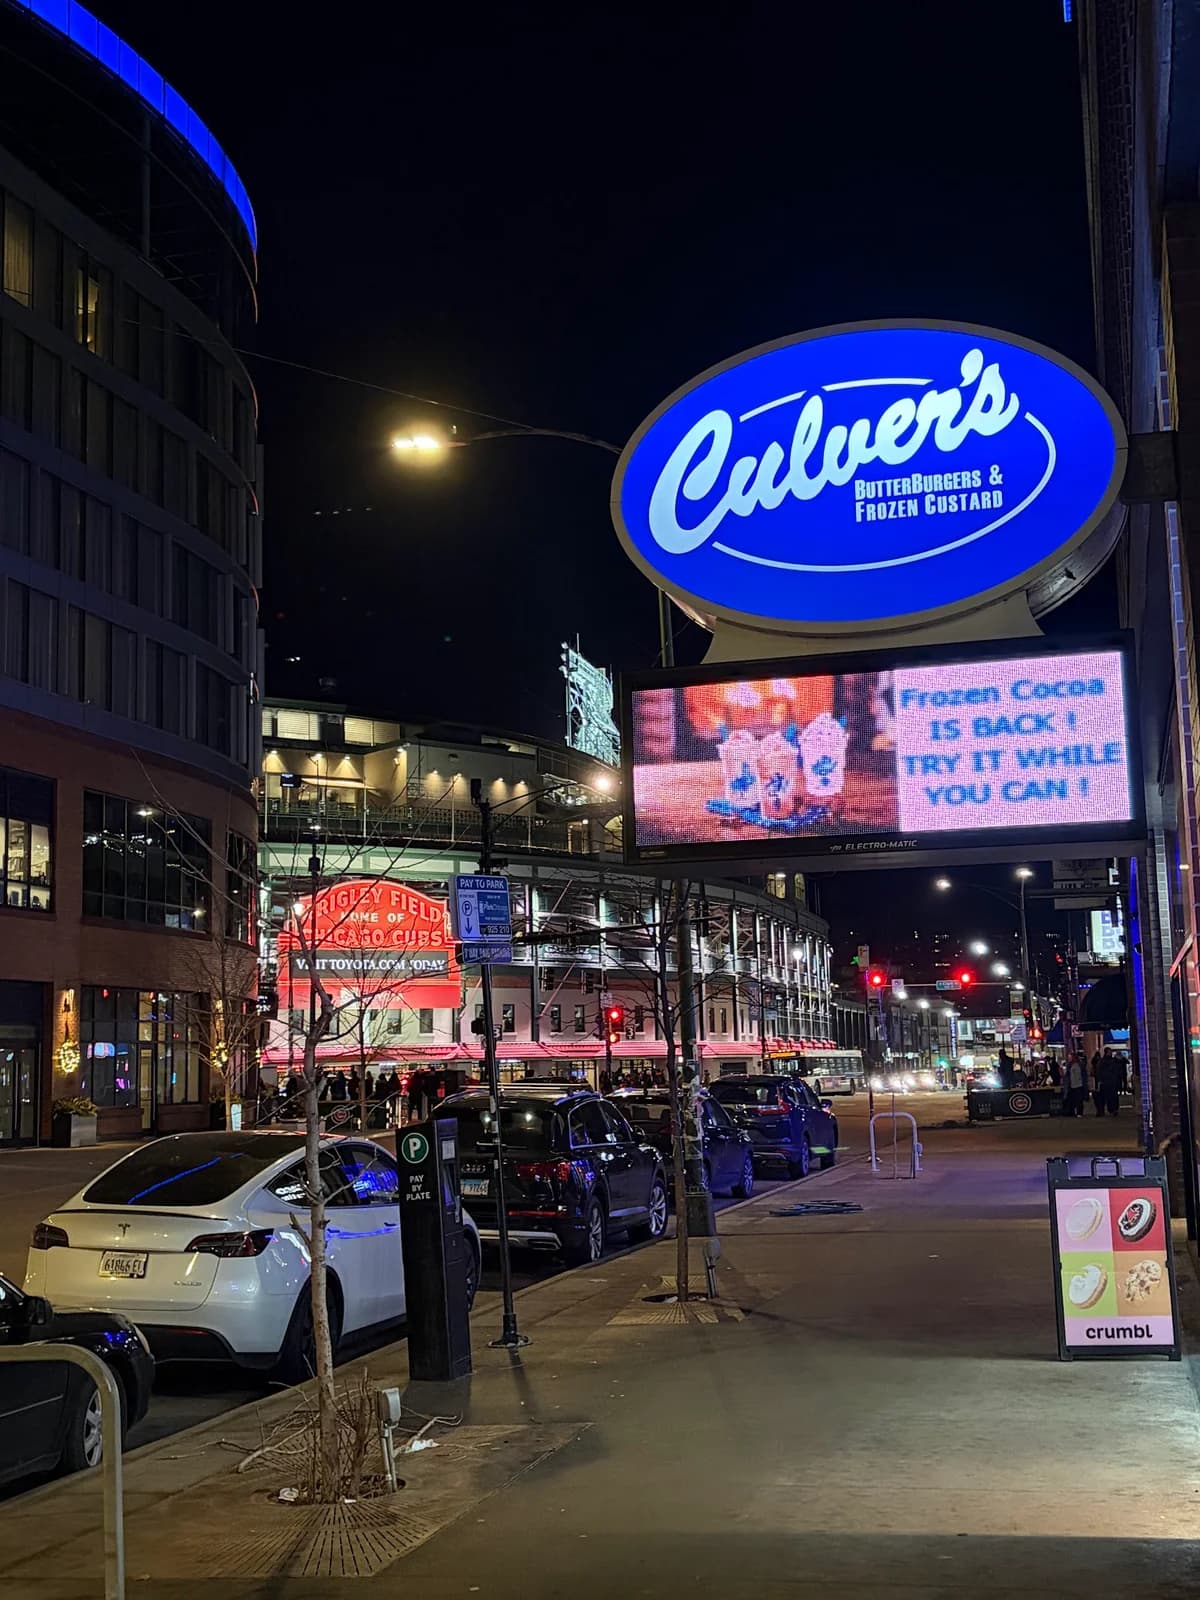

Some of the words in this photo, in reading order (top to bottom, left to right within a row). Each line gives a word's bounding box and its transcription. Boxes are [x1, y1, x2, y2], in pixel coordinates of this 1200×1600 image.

[649, 348, 1019, 554] Culver's
[854, 469, 982, 501] BUTTERBURGERS
[988, 464, 1004, 485] &
[855, 499, 919, 523] FROZEN
[924, 490, 1003, 516] CUSTARD
[900, 686, 1000, 709] Frozen
[1010, 678, 1106, 701] Cocoa
[929, 718, 962, 742] IS
[972, 711, 1056, 738] BACK
[904, 753, 962, 776] TRY
[972, 749, 1003, 773] IT
[1015, 741, 1123, 769] WHILE
[924, 782, 993, 806] YOU
[1001, 778, 1070, 803] CAN
[845, 839, 918, 851] ELECTRO-MATIC
[460, 879, 473, 889] PAY
[475, 880, 485, 889] TO
[486, 879, 504, 889] PARK
[391, 889, 442, 923] FIELD
[387, 912, 405, 923] OF
[392, 929, 443, 947] CUBS
[296, 958, 327, 970] VIT
[409, 1137, 421, 1159] P
[409, 1174, 425, 1184] PAY
[411, 1183, 422, 1193] BY
[406, 1191, 431, 1201] PLATE
[1085, 1324, 1153, 1339] crumbl
